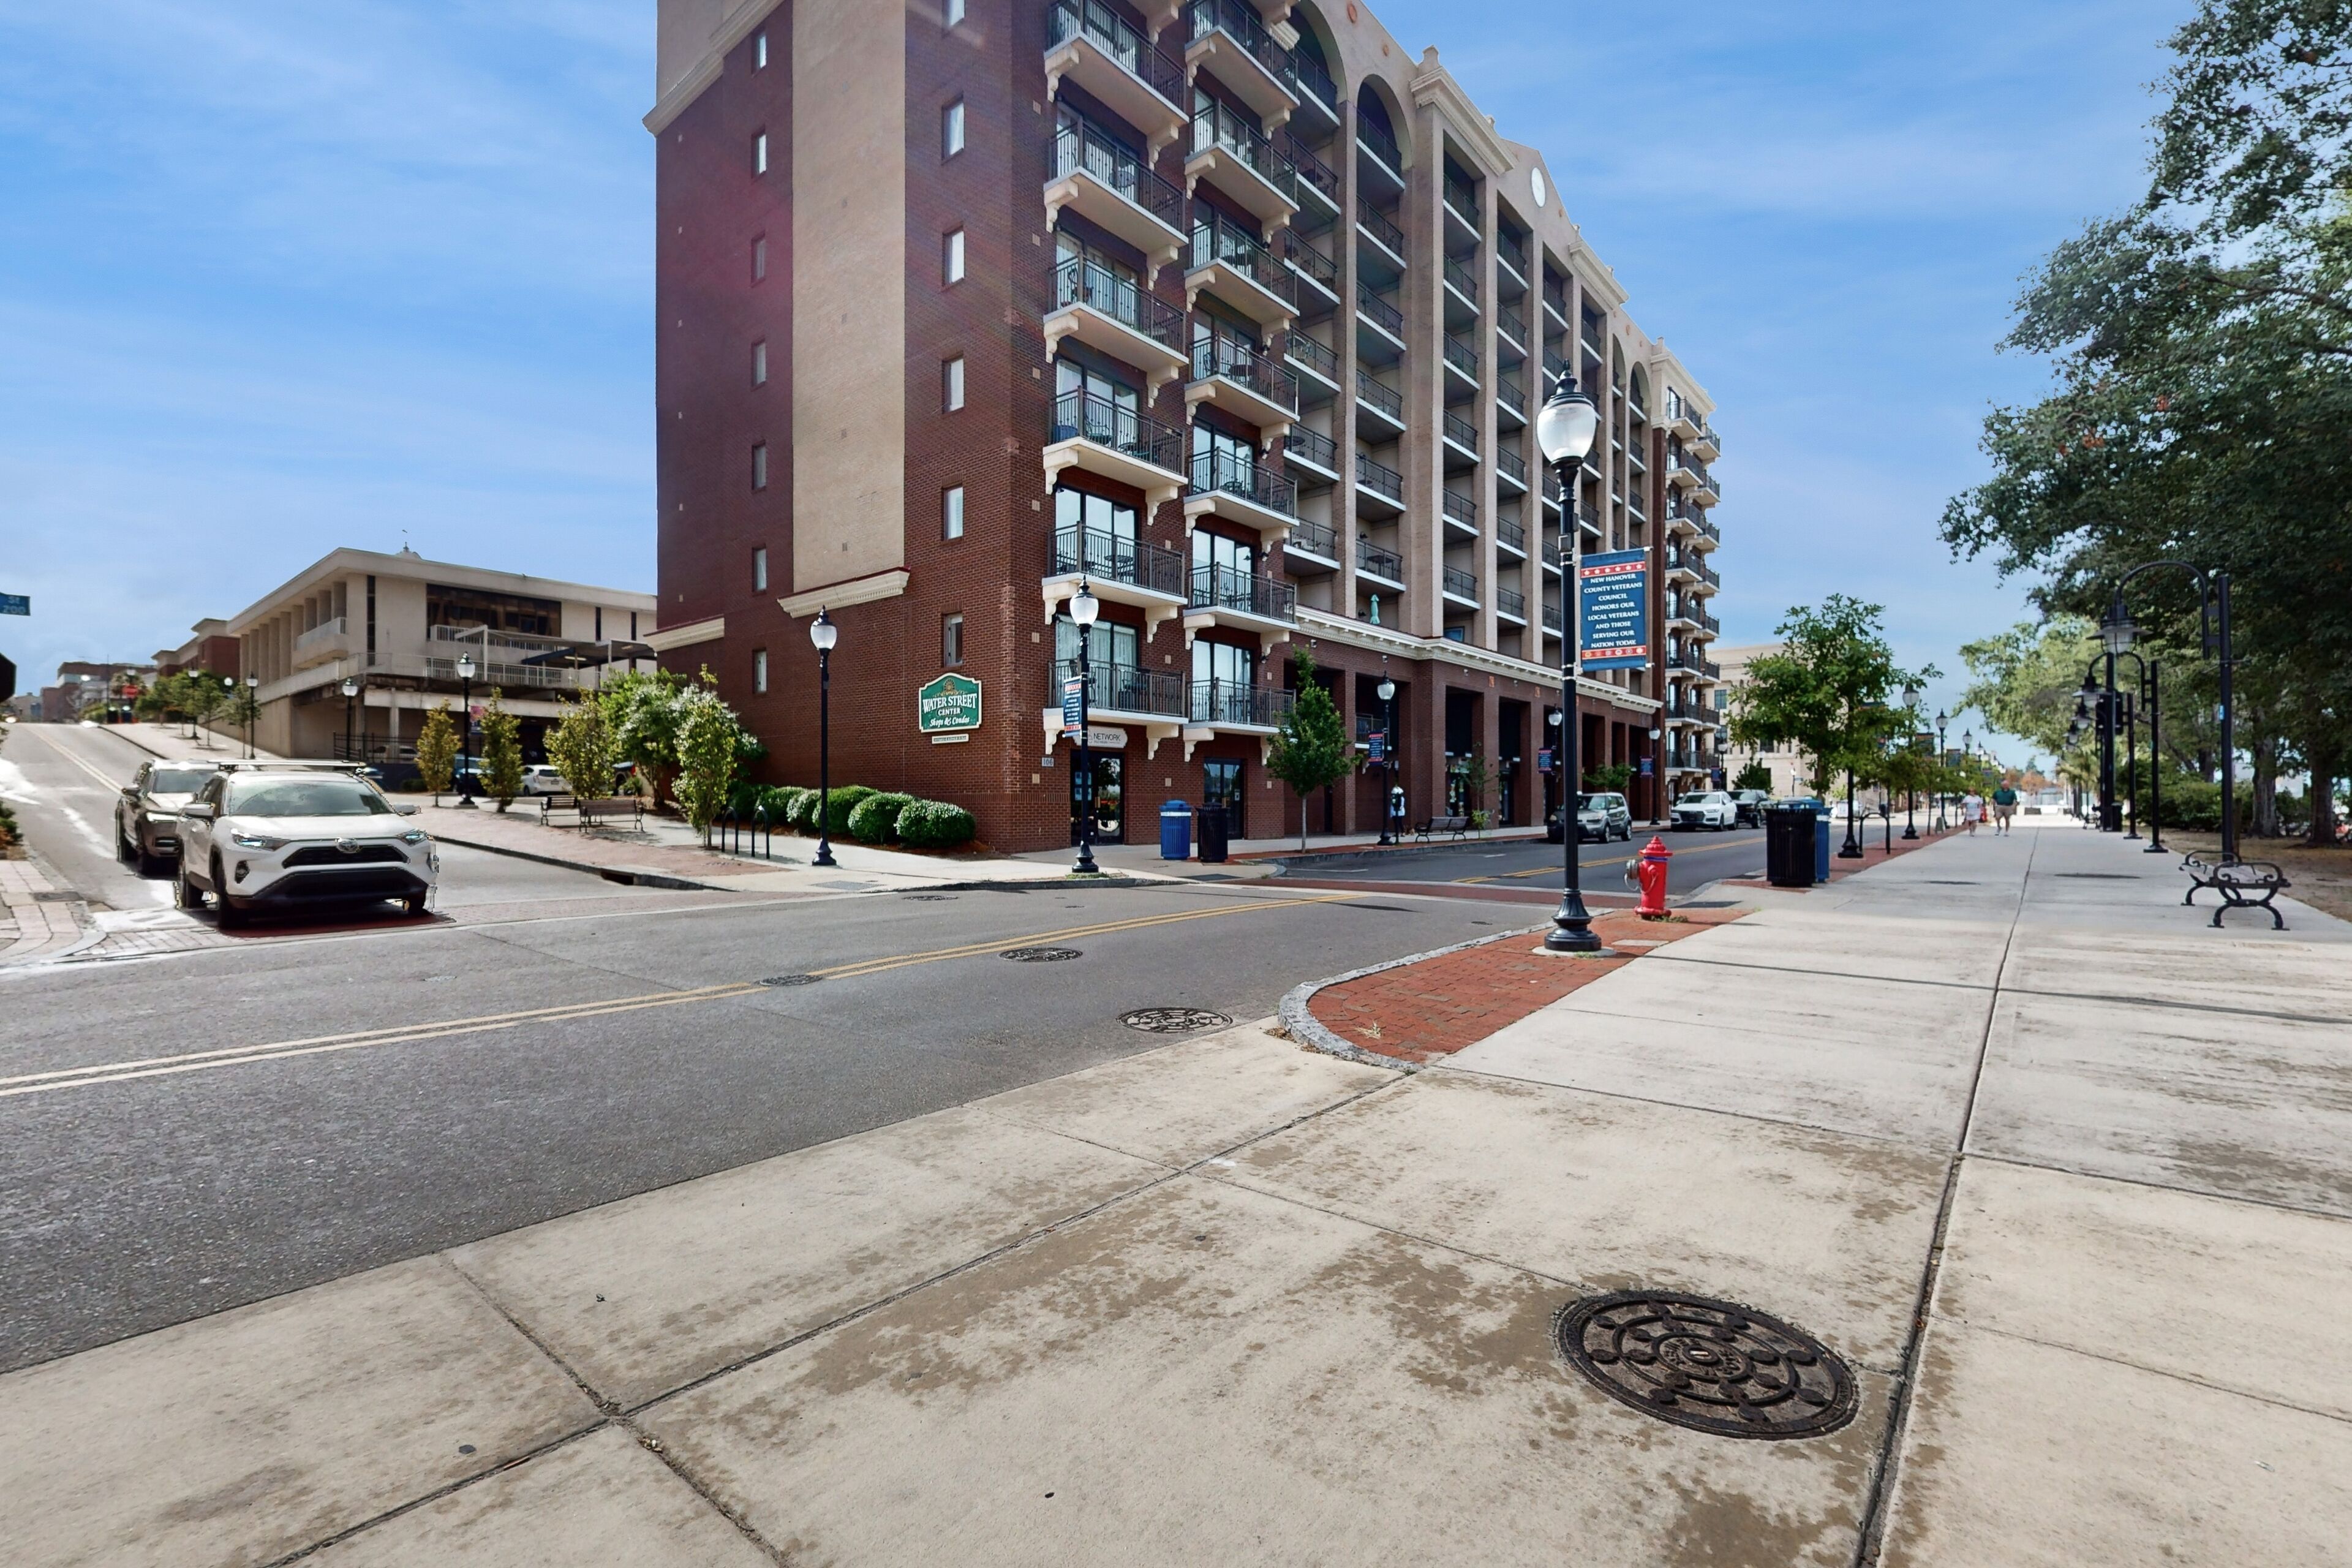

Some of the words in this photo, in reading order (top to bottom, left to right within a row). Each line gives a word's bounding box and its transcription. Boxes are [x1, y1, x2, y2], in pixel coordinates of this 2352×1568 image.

[1605, 573, 1637, 582] HANOVER
[922, 697, 947, 714] WATER
[948, 693, 977, 709] STREET
[938, 707, 960, 716] CENTER
[930, 718, 943, 728] Shops
[944, 717, 951, 726] &
[952, 715, 970, 725] Condos
[1094, 733, 1121, 741] NETWORK
